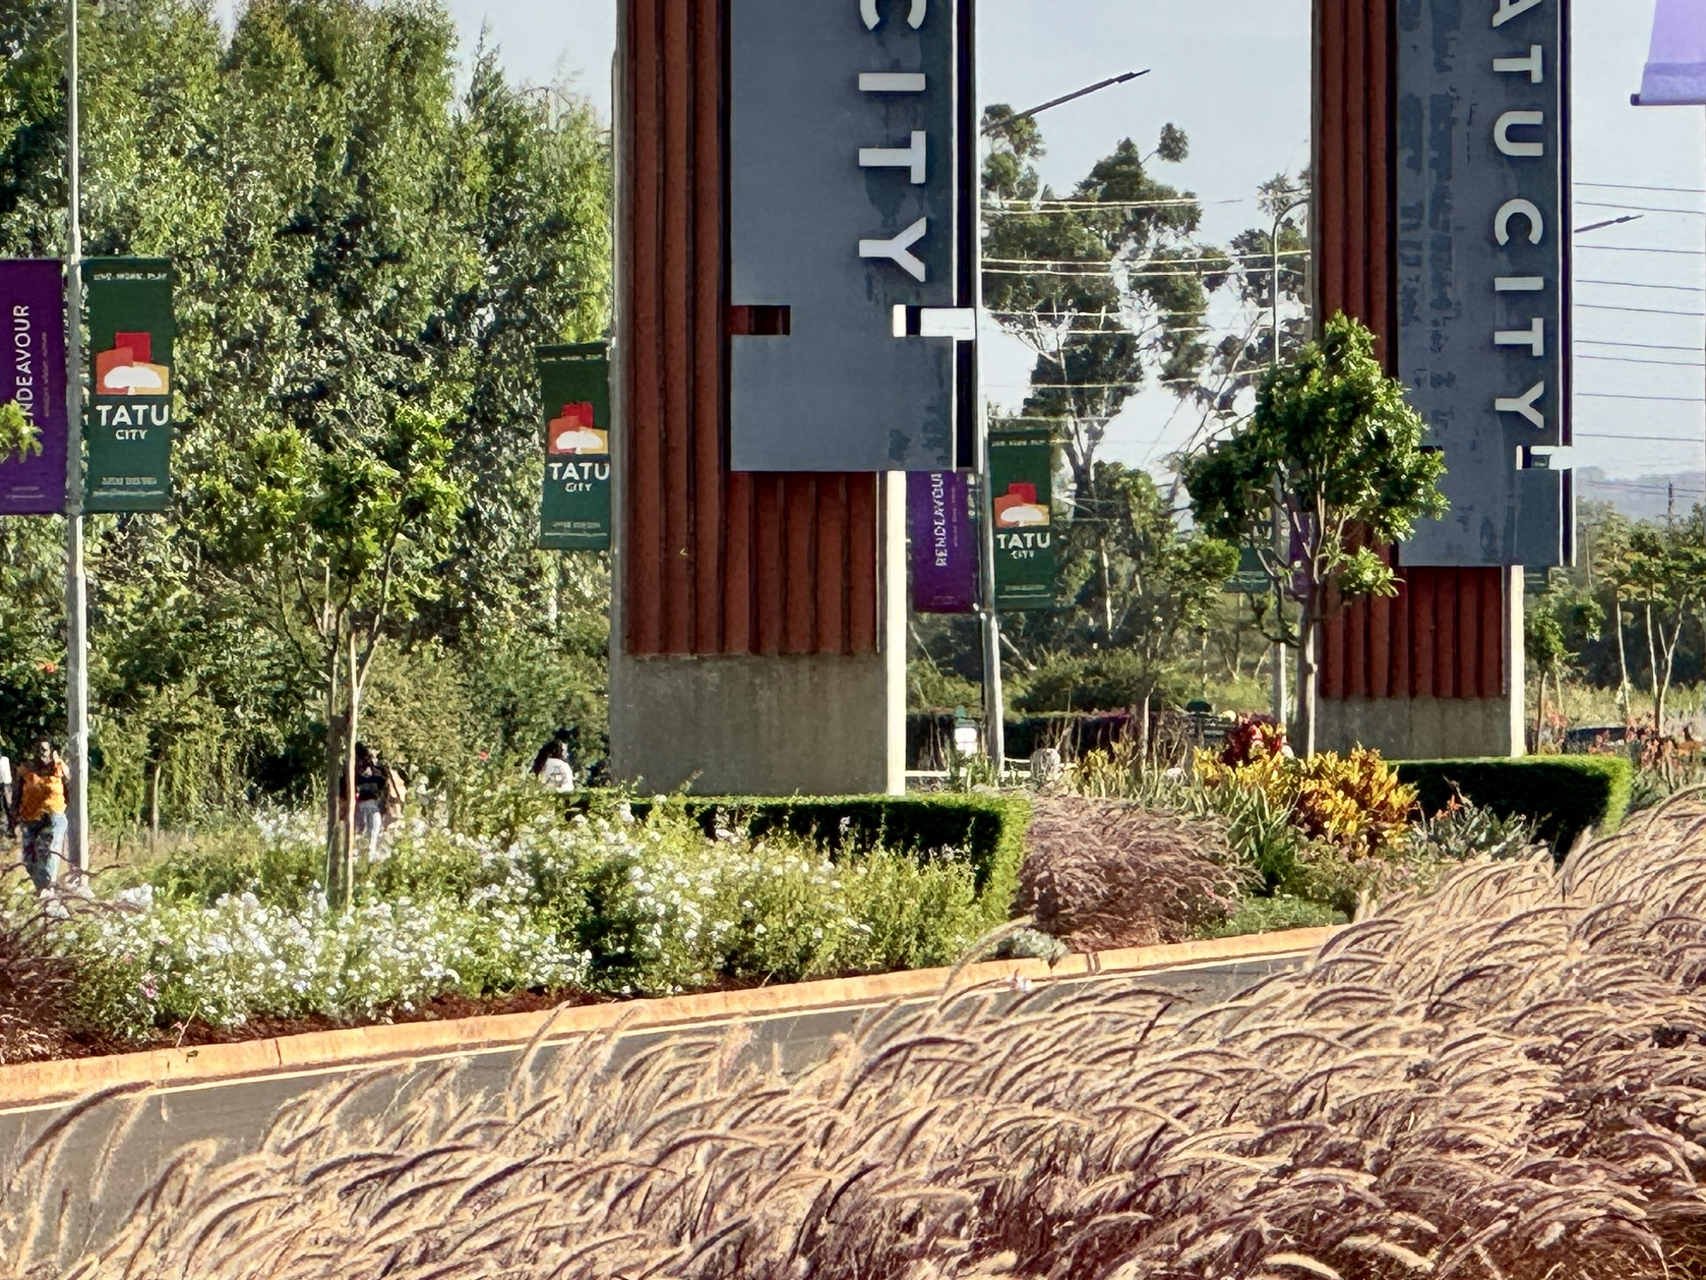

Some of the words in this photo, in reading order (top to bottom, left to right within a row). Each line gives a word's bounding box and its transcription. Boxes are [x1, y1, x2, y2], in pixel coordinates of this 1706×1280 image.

[1493, 197, 1545, 430] CITY
[12, 304, 34, 427] NDEAVOUR
[96, 405, 169, 426] TATU
[115, 429, 148, 441] CITY
[549, 462, 609, 480] TATU
[996, 532, 1050, 549] TATU
